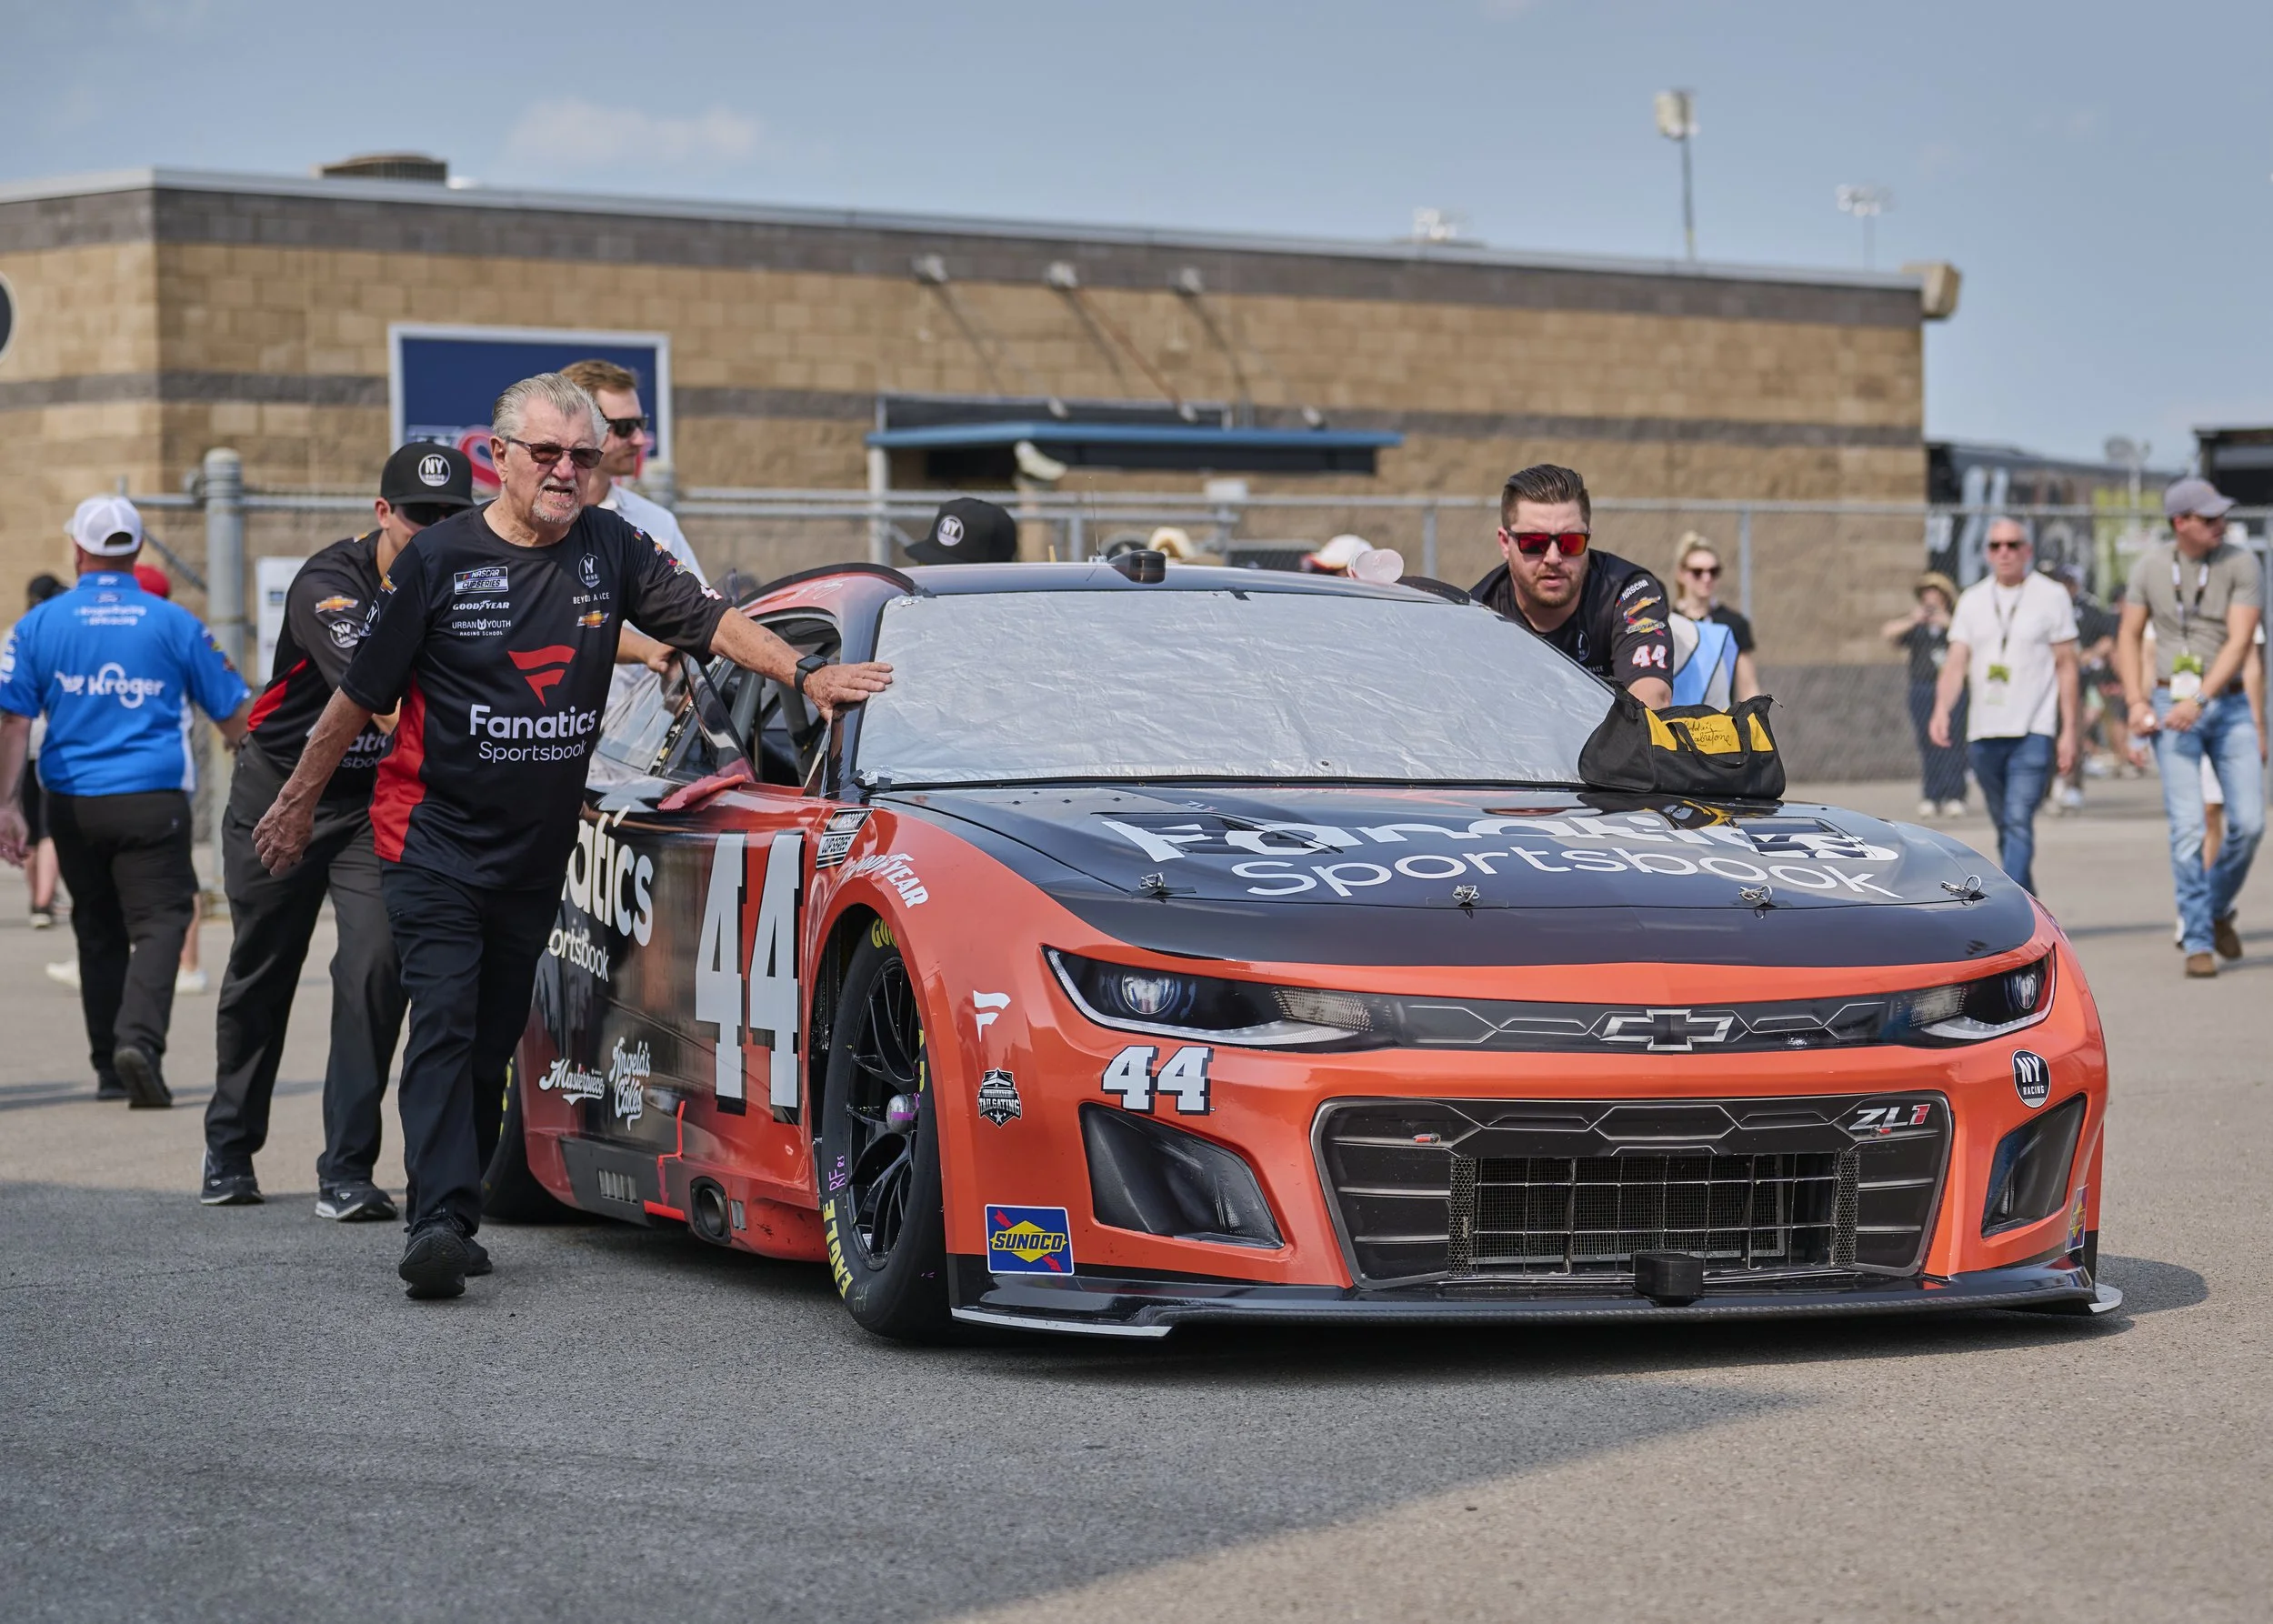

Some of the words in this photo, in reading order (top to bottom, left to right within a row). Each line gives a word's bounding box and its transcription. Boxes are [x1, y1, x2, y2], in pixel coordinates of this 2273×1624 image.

[425, 457, 445, 475] NY
[462, 581, 477, 589] CUP
[476, 579, 501, 588] SERIES
[471, 569, 500, 578] NASCAR
[452, 600, 510, 611] GOODYEAR
[452, 621, 477, 629] URBAN
[486, 619, 512, 628] YOUTH
[1632, 644, 1667, 669] 44
[87, 661, 165, 709] Kroger
[469, 703, 596, 739] Fanatics
[478, 740, 587, 764] Sportsbook
[1101, 816, 1899, 862] Fanatics
[561, 805, 654, 947] atics
[1231, 846, 1904, 898] Sportsbook
[548, 927, 610, 982] ortsbook
[696, 830, 807, 1111] 44
[539, 1058, 605, 1101] Masterpiece
[1102, 1045, 1214, 1116] 44
[2015, 1056, 2040, 1083] NY
[2022, 1085, 2045, 1096] RACING
[978, 1098, 1020, 1117] TAILGATING
[1848, 1103, 1931, 1131] ZL1
[828, 1168, 846, 1191] RF
[822, 1198, 854, 1299] EAGLE
[994, 1232, 1063, 1250] SUNOCO
